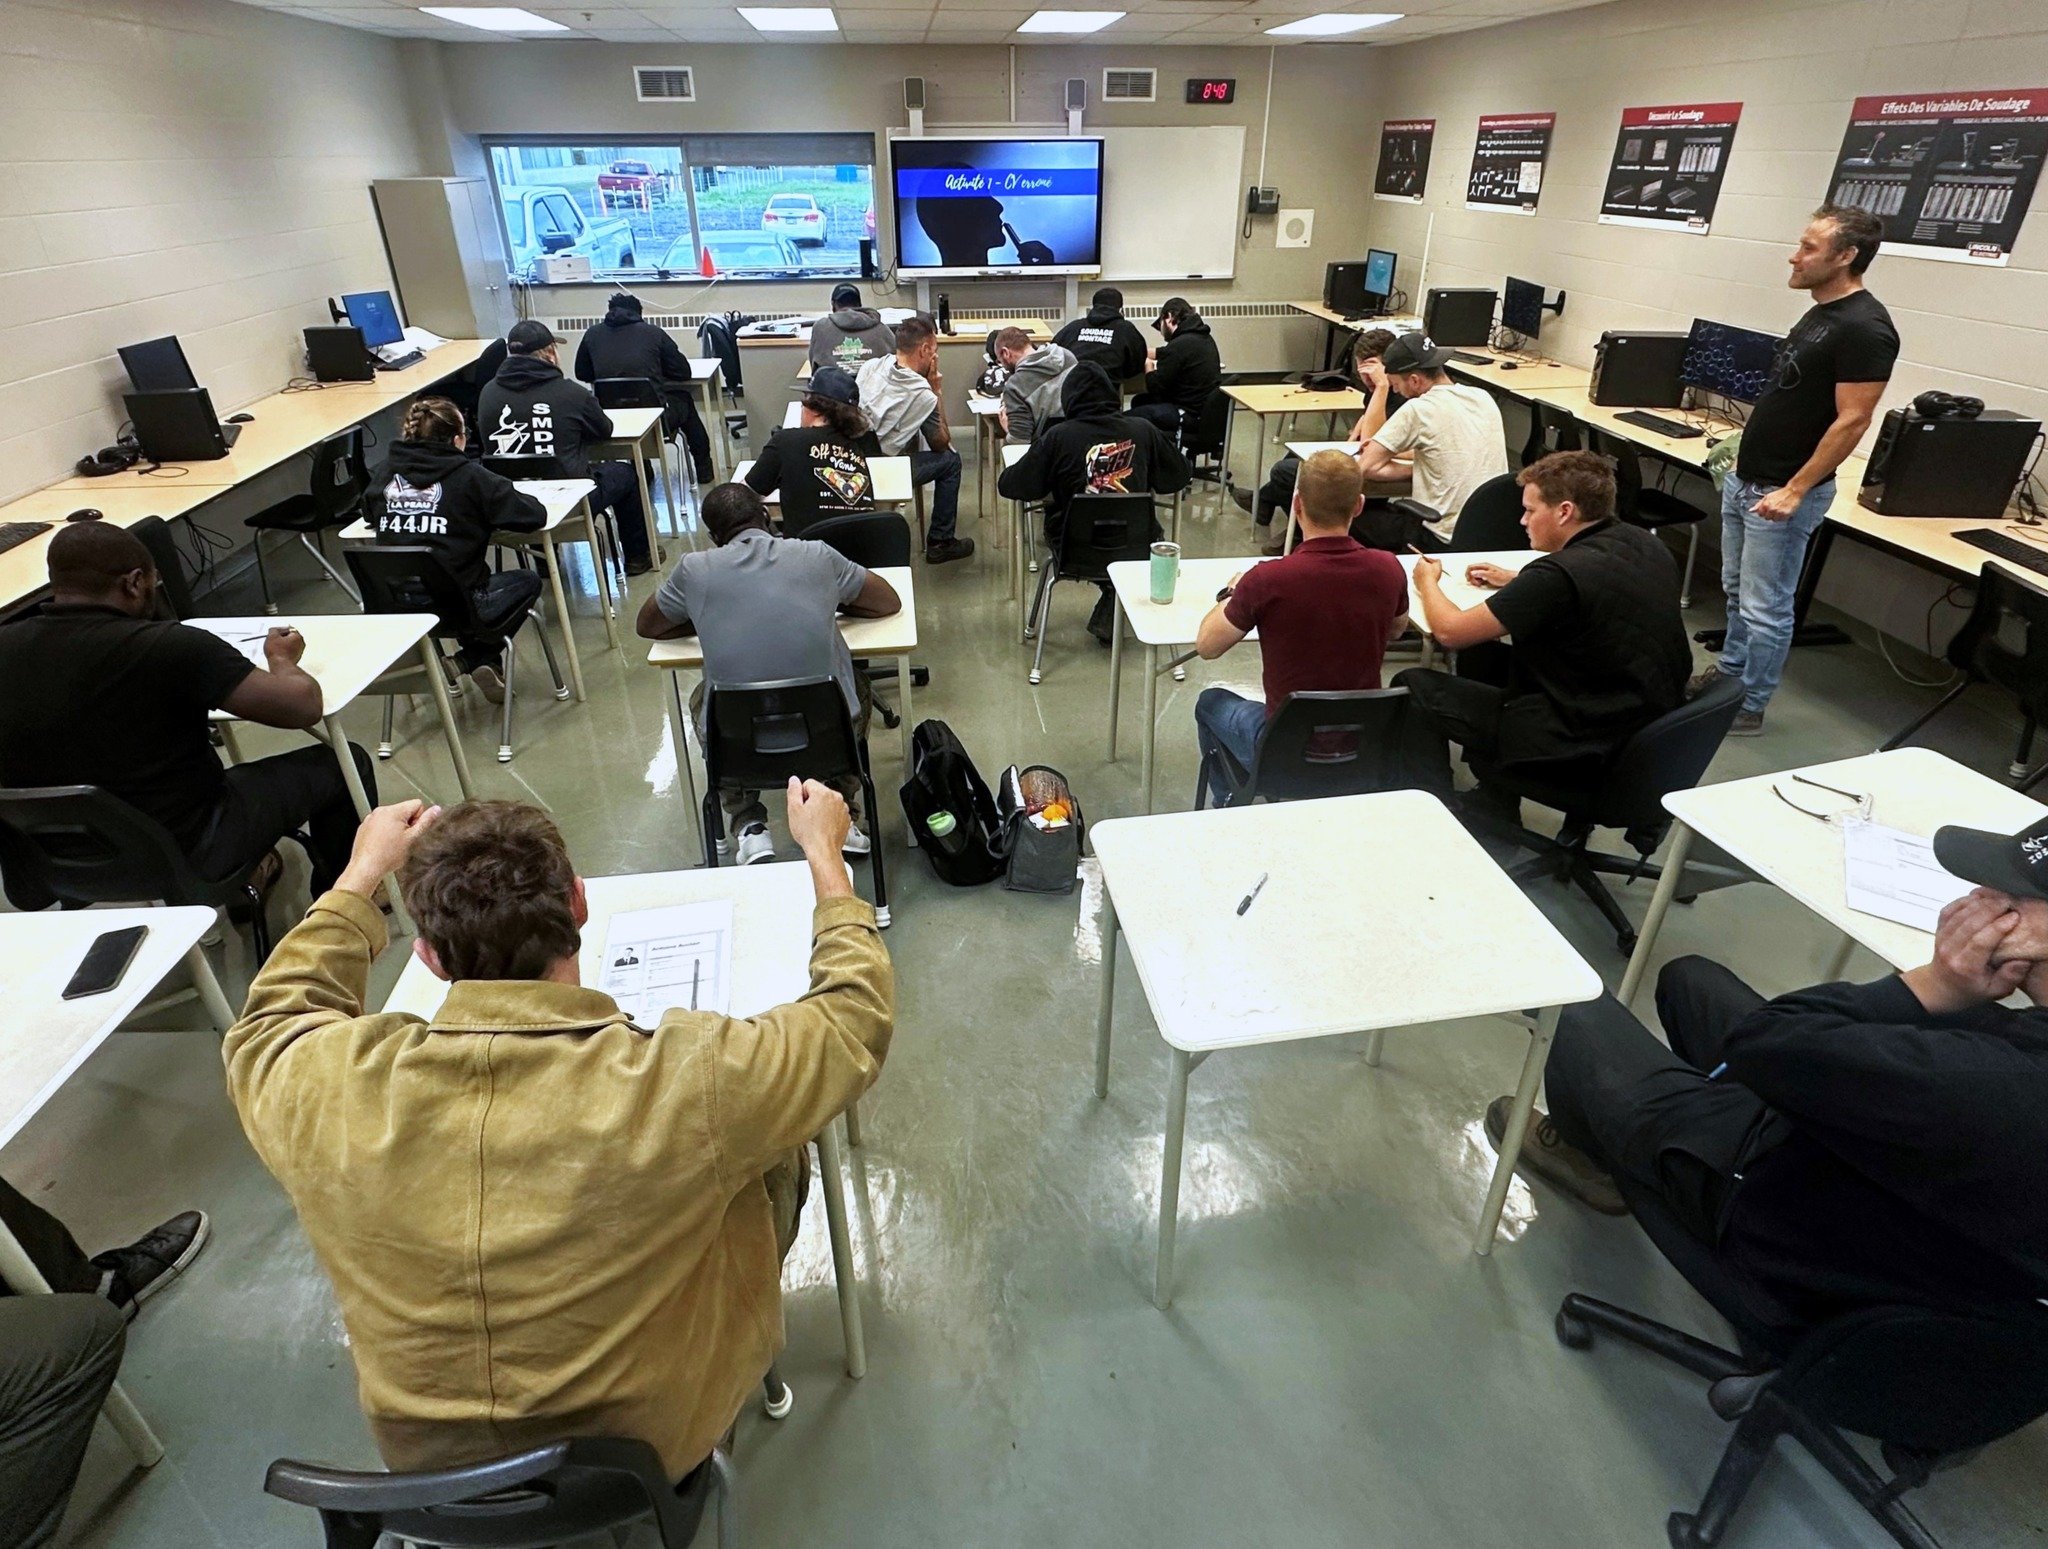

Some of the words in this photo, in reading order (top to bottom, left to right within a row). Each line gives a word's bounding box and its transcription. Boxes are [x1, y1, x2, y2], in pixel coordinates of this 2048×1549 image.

[1881, 102, 1908, 115] Effets
[1908, 101, 1925, 113] Des
[1925, 98, 1969, 113] Variables
[1968, 98, 1983, 112] De
[1983, 97, 2031, 113] Soudage
[1679, 110, 1704, 122] Soudage
[945, 174, 985, 191] Activité
[987, 177, 993, 190] 1
[1004, 173, 1023, 190] CV
[1021, 176, 1053, 189] erroné
[1968, 243, 1998, 252] LINCOLN
[1080, 327, 1114, 337] SOUDAGE
[1077, 334, 1113, 345] MONTAGE
[809, 443, 830, 460] Off
[829, 456, 856, 471] Vans
[390, 501, 403, 509] LA
[403, 501, 431, 509] PEAU
[379, 515, 448, 534] #44JR
